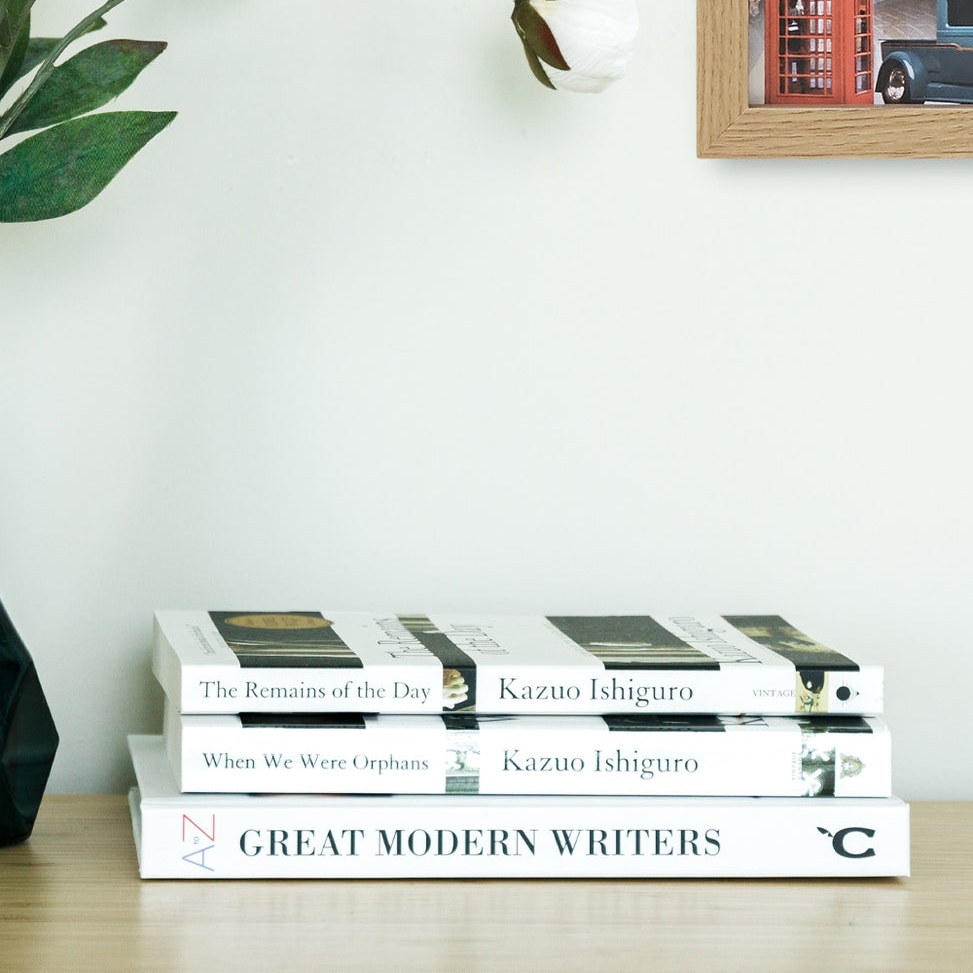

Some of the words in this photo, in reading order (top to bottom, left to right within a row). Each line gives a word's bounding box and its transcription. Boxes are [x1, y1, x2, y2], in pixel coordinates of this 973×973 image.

[199, 681, 238, 699] The
[245, 681, 326, 699] Remains
[332, 681, 354, 699] of
[357, 681, 386, 699] the
[393, 681, 431, 705] Day
[498, 678, 581, 700] Kazuo
[590, 678, 694, 707] Ishiguro
[752, 689, 796, 697] VINTAGE
[202, 753, 256, 770] When
[263, 753, 293, 770] We
[300, 753, 347, 770] Were
[352, 753, 429, 775] Orphans
[502, 750, 585, 772] Kazuo
[594, 749, 699, 780] Ishiguro
[182, 814, 215, 841] Z
[239, 829, 365, 857] GREAT
[375, 828, 538, 857] MODERN
[549, 828, 721, 857] WRITERS
[182, 845, 215, 871] A
